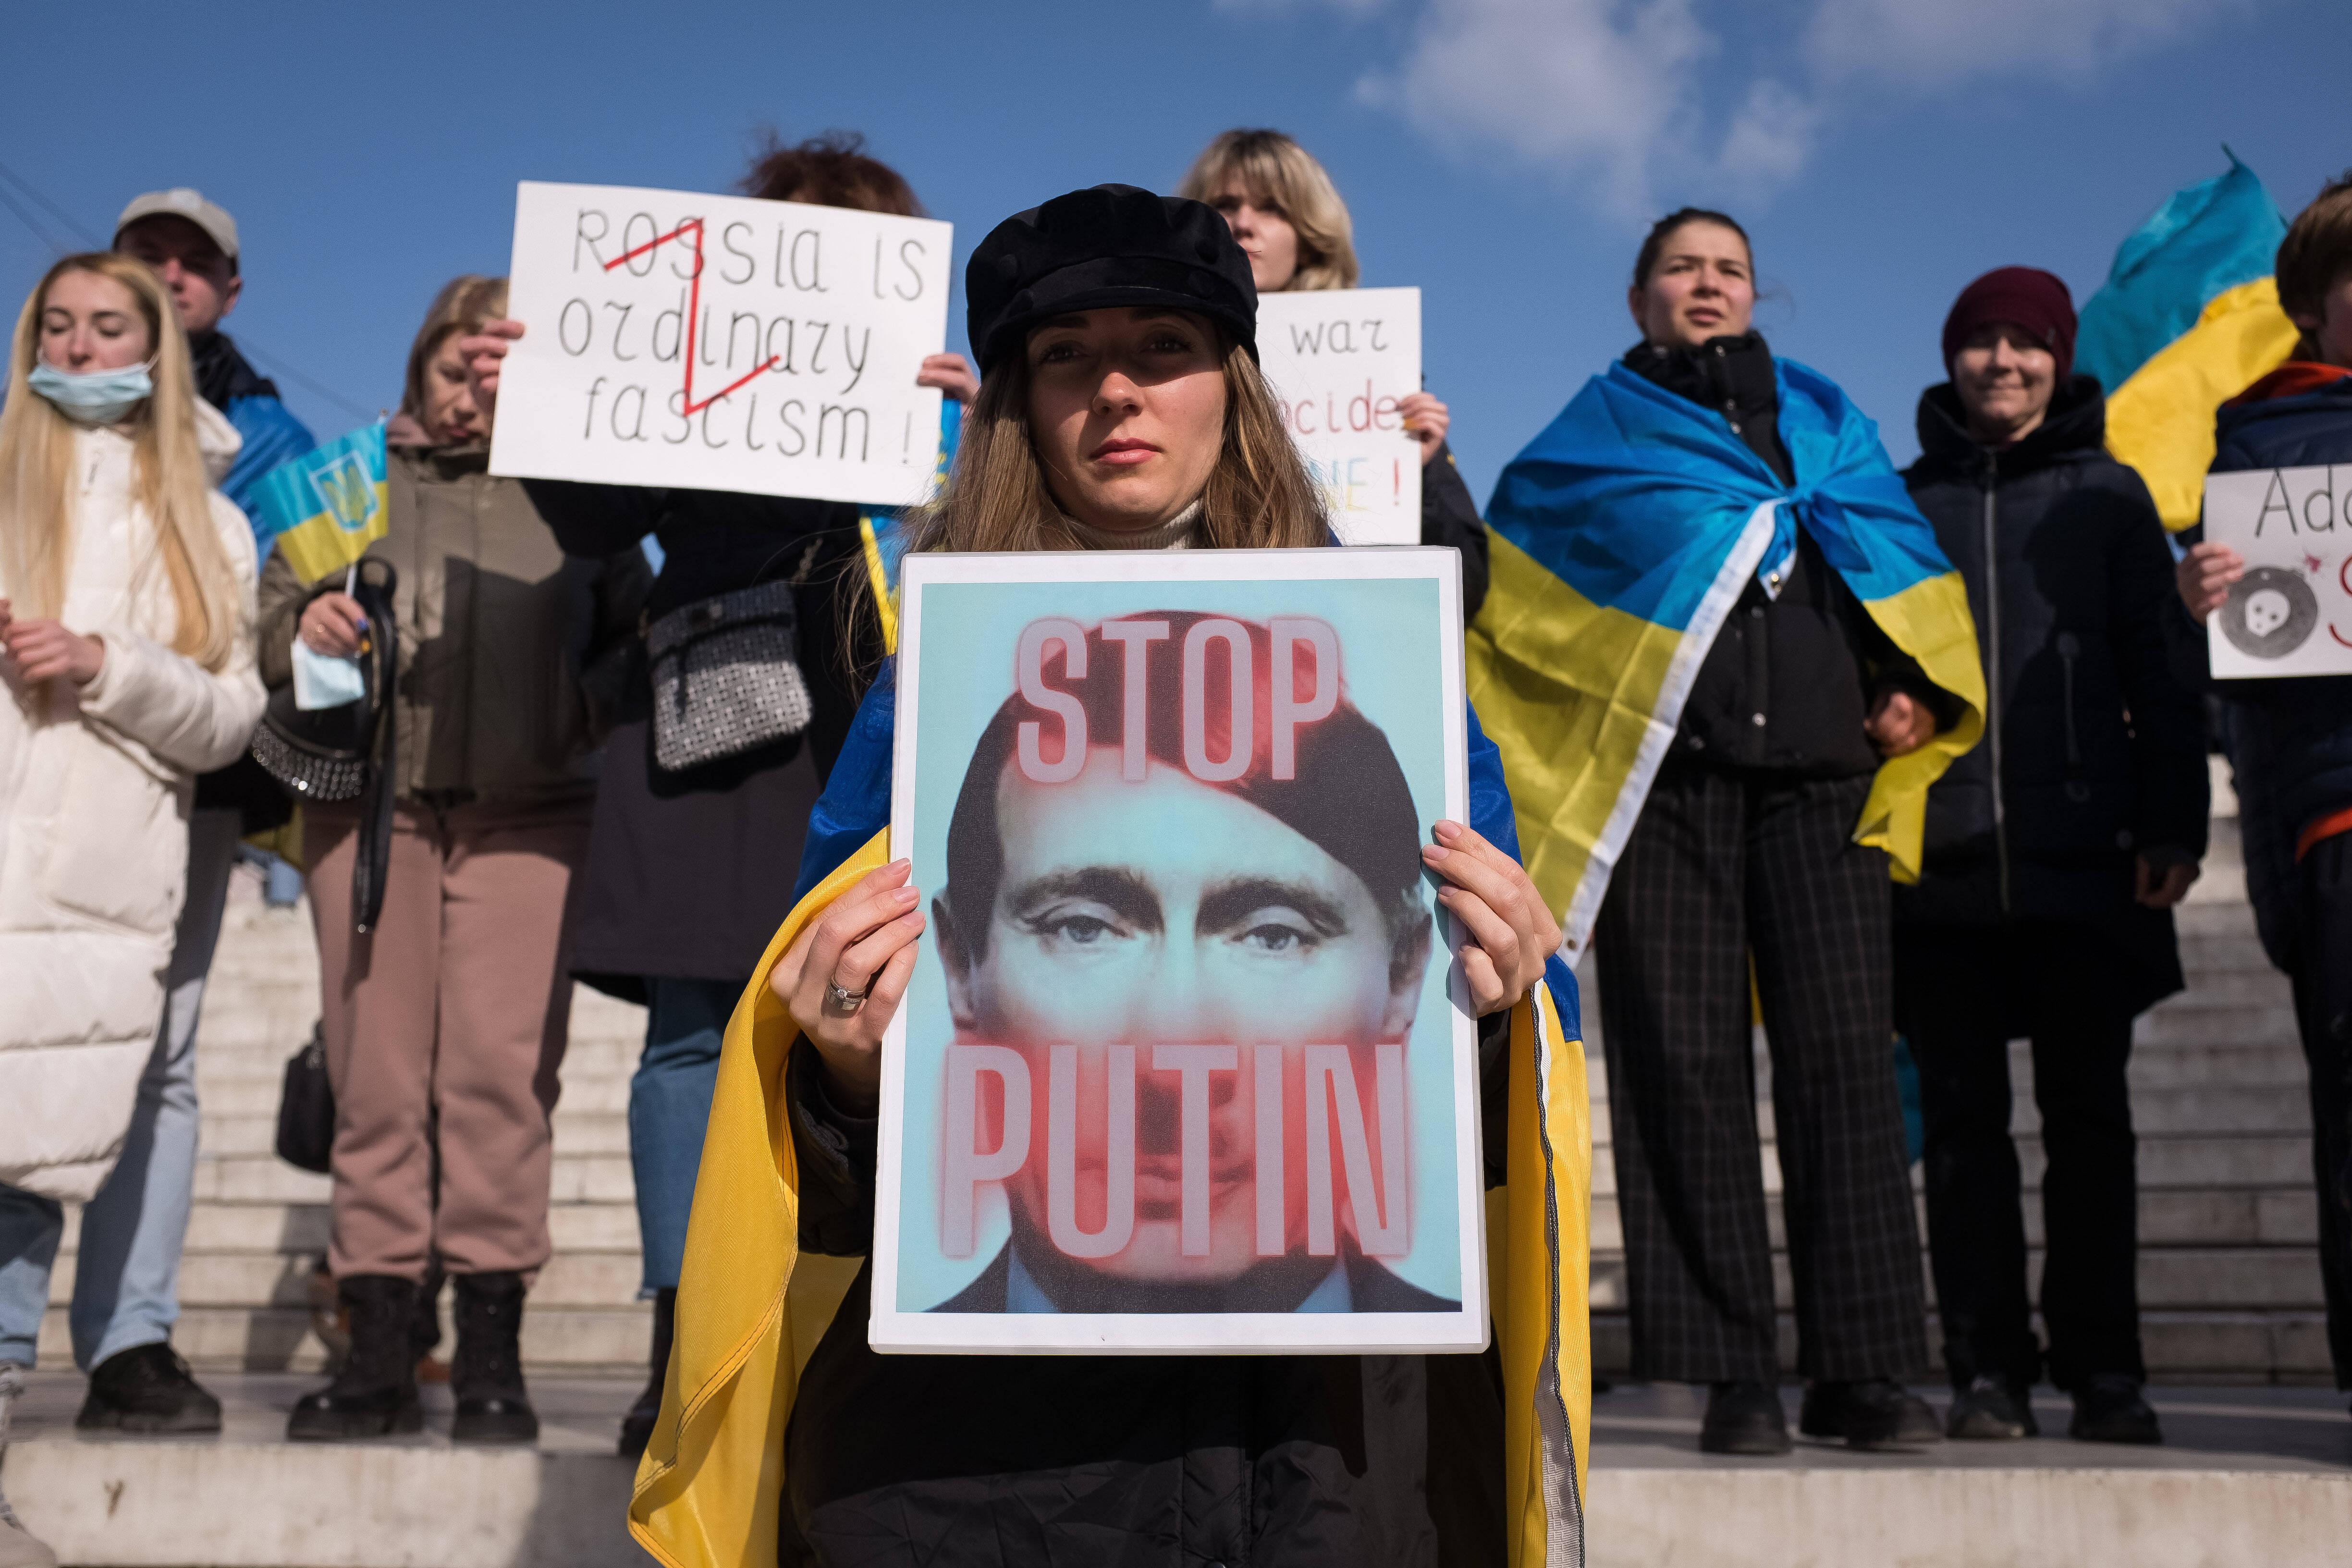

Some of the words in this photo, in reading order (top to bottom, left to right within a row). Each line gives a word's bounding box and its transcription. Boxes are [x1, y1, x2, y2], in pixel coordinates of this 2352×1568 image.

[559, 286, 870, 396] ordinary
[1289, 319, 1389, 355] war
[1015, 617, 1338, 783] STOP
[940, 1043, 1410, 1258] PUTIN
